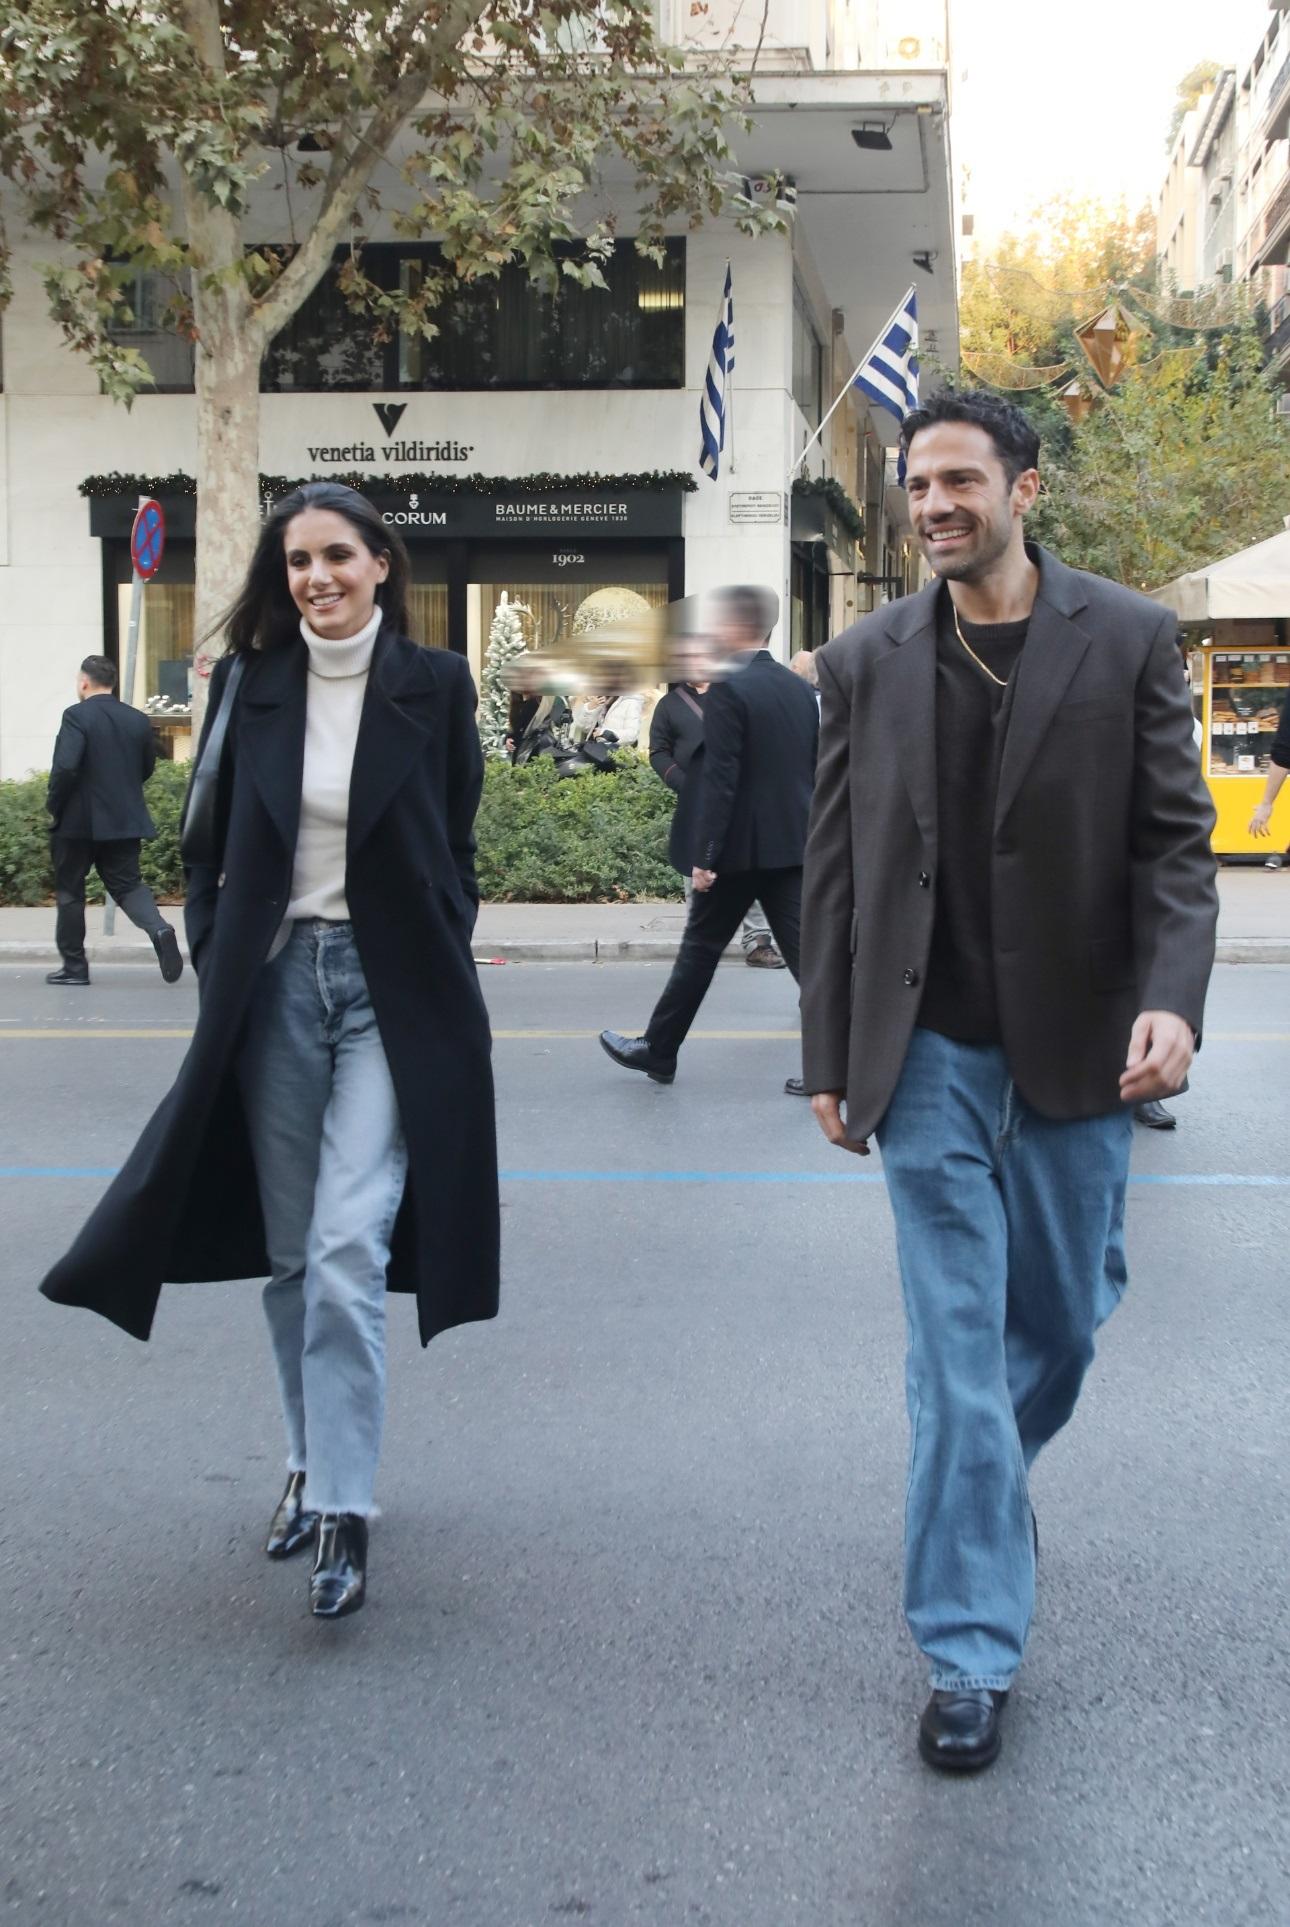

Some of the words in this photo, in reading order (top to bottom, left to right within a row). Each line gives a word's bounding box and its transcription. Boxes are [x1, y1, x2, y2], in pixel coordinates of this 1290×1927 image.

[307, 441, 375, 462] venetia
[381, 441, 468, 461] vildiridis
[495, 504, 547, 515] BAUME
[560, 503, 628, 515] MERCIER
[382, 512, 447, 525] CORUM
[551, 554, 585, 567] 1902
